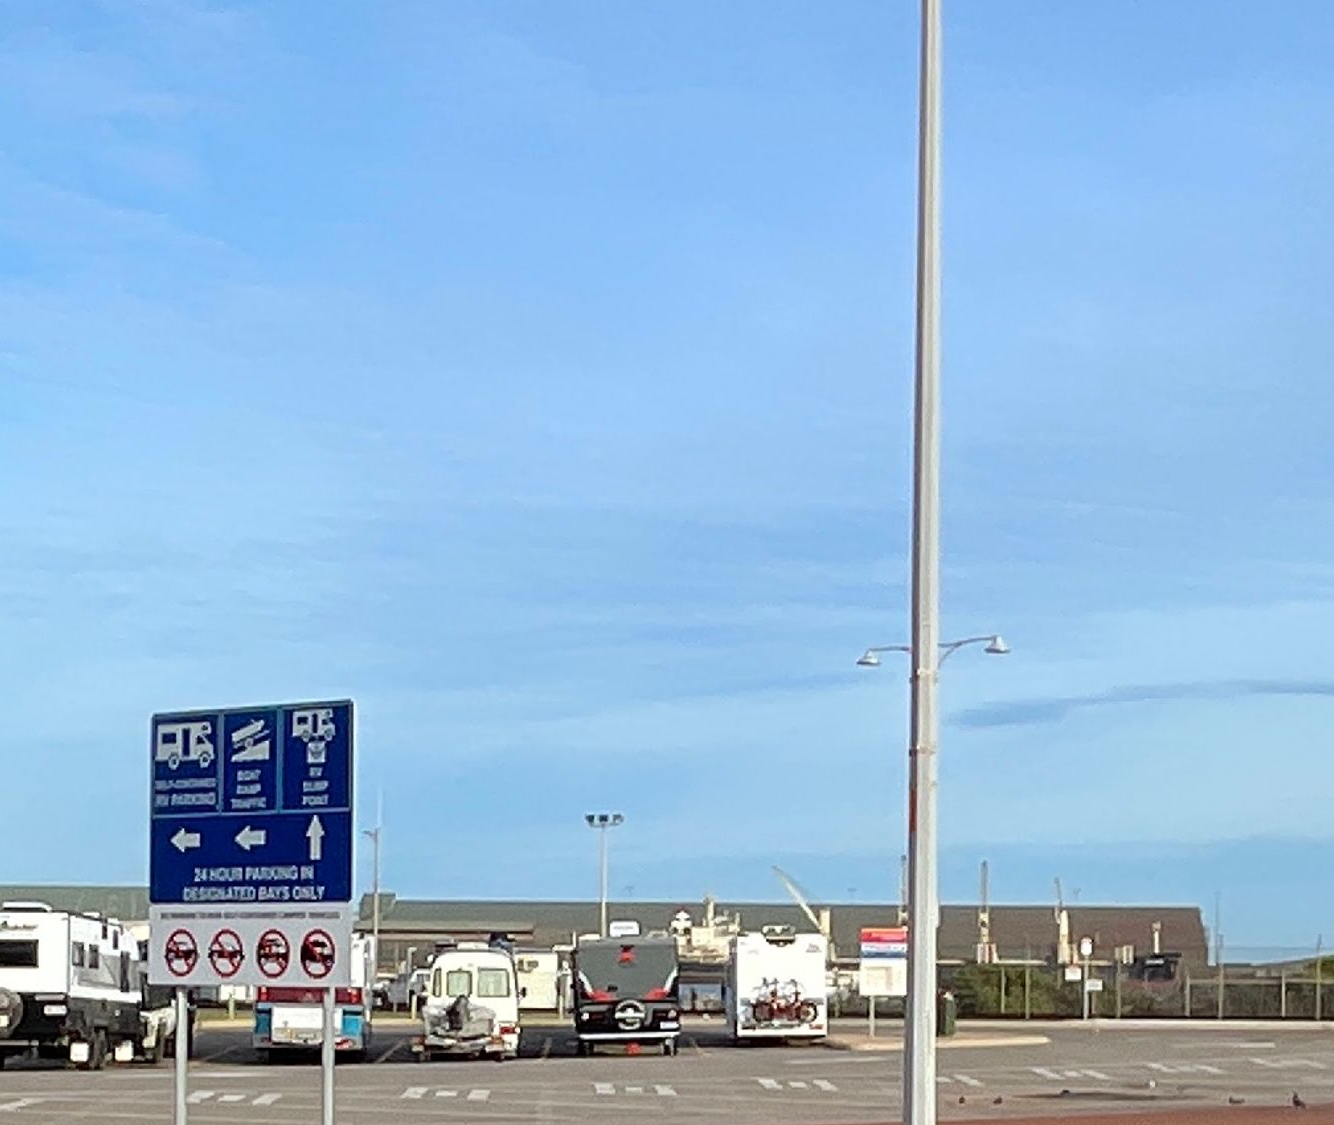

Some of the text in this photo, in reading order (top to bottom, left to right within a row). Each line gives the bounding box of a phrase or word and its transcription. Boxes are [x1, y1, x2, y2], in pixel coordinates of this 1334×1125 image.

[236, 769, 261, 781] BOAT
[170, 792, 216, 806] PARKING
[302, 794, 329, 806] POINT
[194, 865, 314, 881] 24 HOUR PARKING IN
[183, 885, 325, 901] DESIGNATED BAYS ONLY
